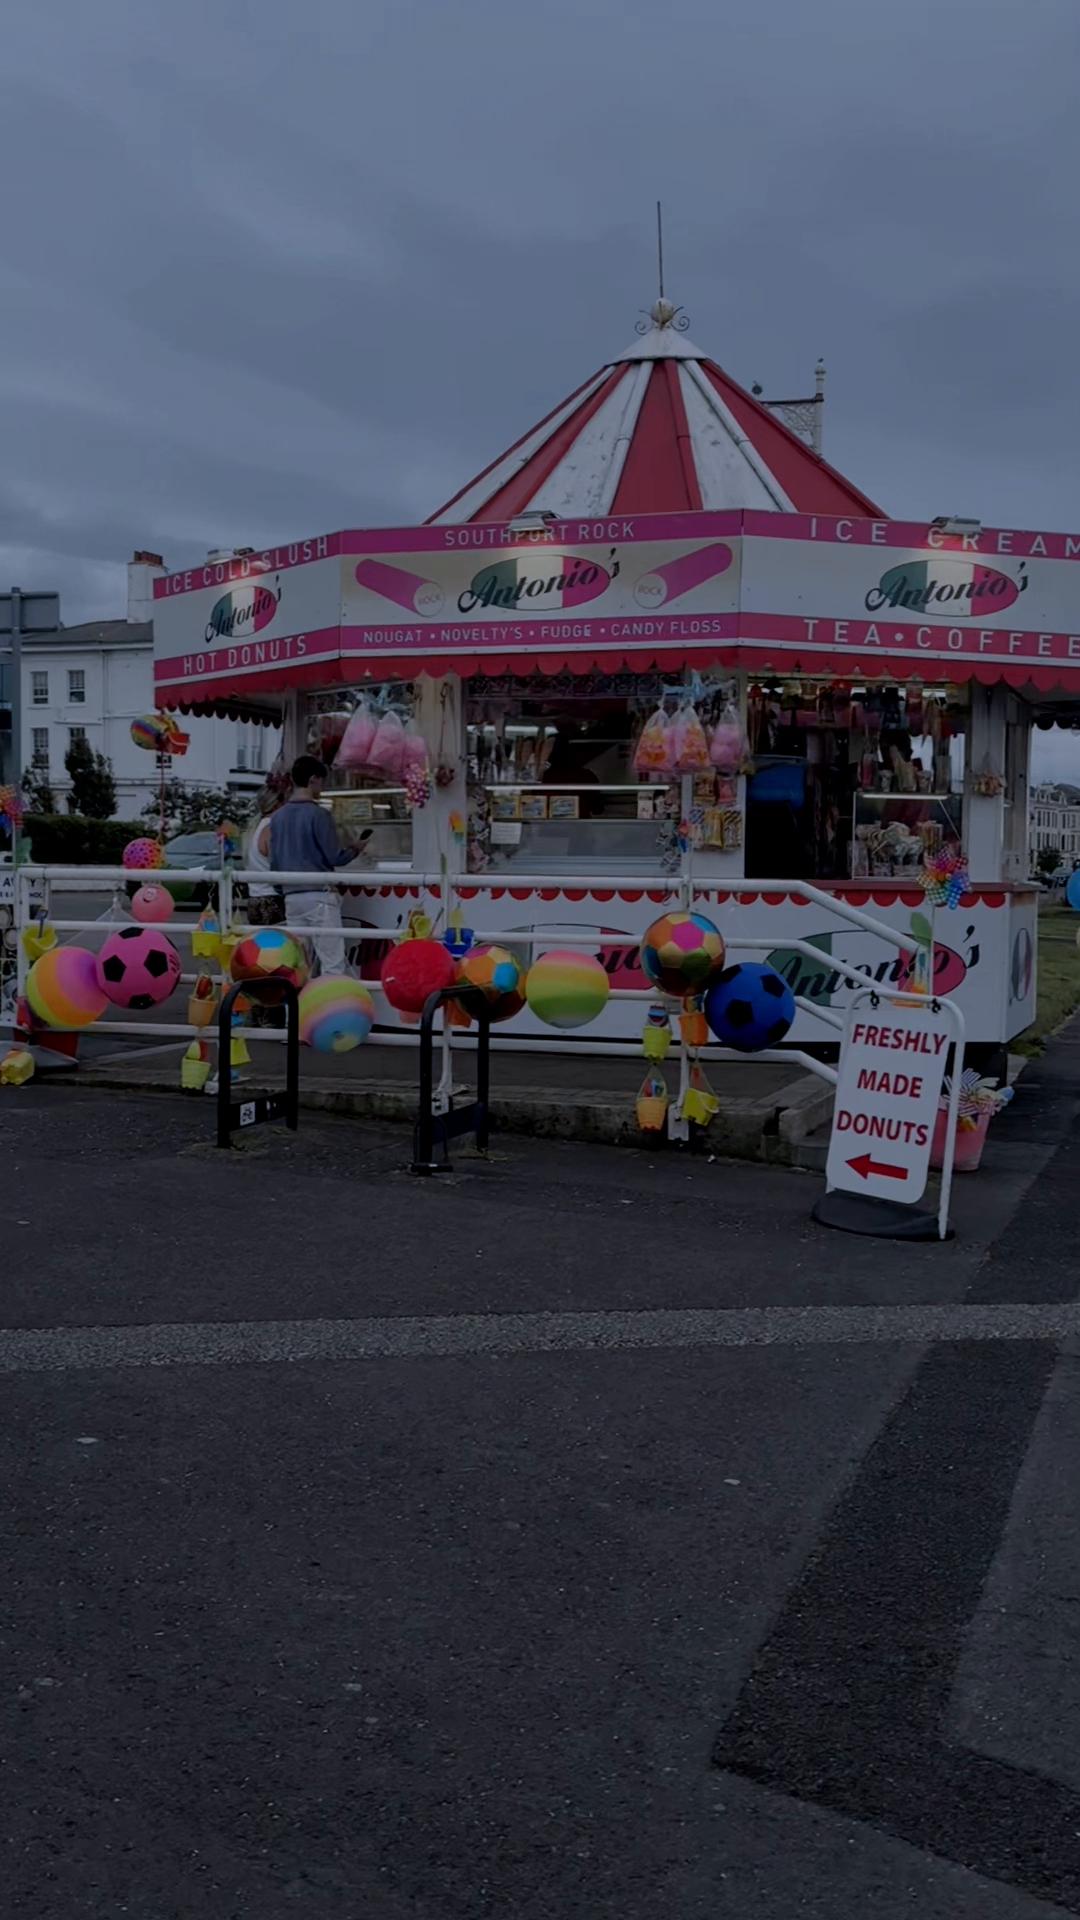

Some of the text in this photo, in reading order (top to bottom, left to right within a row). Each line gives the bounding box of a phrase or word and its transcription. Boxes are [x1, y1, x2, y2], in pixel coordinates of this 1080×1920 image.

[444, 521, 636, 546] SOUTHPORT ROCK
[810, 517, 1080, 557] ICE CREAM
[164, 535, 329, 595] ICE COLD SLUSH
[458, 548, 620, 613] Antonio's
[638, 584, 662, 596] ROCK
[865, 561, 1029, 611] Antonio's
[204, 574, 282, 643] Antonio's
[363, 619, 722, 644] NOUGAT NOVELTY'S FUDGE CANDY FLOSS
[804, 618, 1080, 657] TEA COFFEE
[183, 635, 307, 675] HOT DONUTS
[852, 1023, 947, 1055] FRESHLY
[857, 1068, 924, 1098] MADE
[836, 1110, 929, 1146] DONUTS
